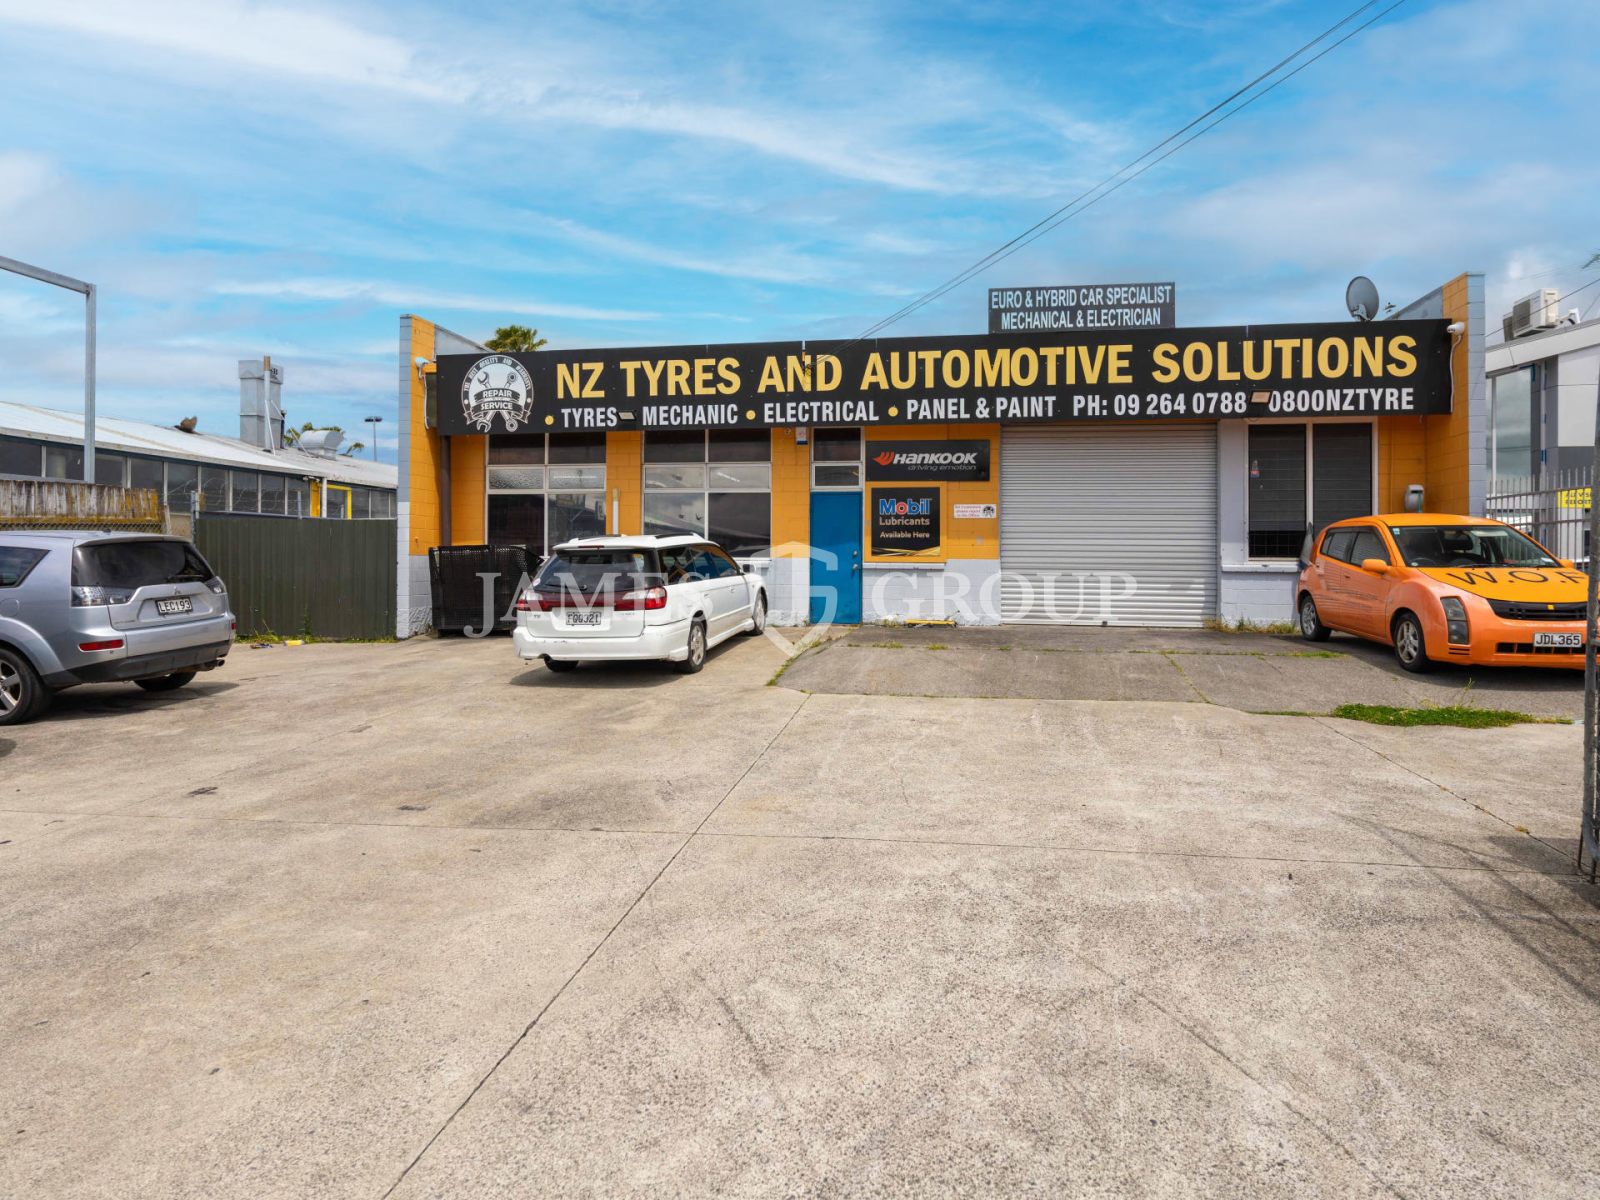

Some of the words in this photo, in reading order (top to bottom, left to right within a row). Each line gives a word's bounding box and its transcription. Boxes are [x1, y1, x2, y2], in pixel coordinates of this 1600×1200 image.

[991, 290, 1023, 309] EURO
[1025, 290, 1033, 307] &
[1036, 288, 1077, 307] HYBRID
[1080, 287, 1103, 306] CAR
[1107, 285, 1172, 305] SPECIALIST
[1001, 310, 1073, 330] MECHANICAL
[1076, 310, 1084, 327] &
[1087, 307, 1161, 327] ELECTRICIAN
[557, 362, 605, 399] NZ
[619, 357, 741, 397] TYRES
[757, 354, 842, 393] AND
[860, 344, 1133, 390] AUTOMOTIVE
[1151, 335, 1418, 384] SOLUTIONS
[482, 389, 513, 398] REPAIR
[480, 402, 513, 411] SERVICE
[561, 407, 618, 428] TYRES
[642, 403, 738, 426] MECHANIC
[764, 400, 879, 424] ELECTRICAL
[907, 398, 970, 420] PANEL
[975, 397, 990, 419] &
[996, 396, 1056, 419] PAINT
[1073, 395, 1107, 416] PH:
[1114, 393, 1140, 415] 09
[1146, 393, 1186, 415] 264
[1192, 391, 1247, 414] 0788
[1268, 387, 1414, 413] 0800NZTYRE
[879, 498, 930, 515] Mobil
[879, 517, 930, 526] Lubricants
[158, 599, 191, 612] LEC193
[1535, 633, 1581, 646] JDL365
